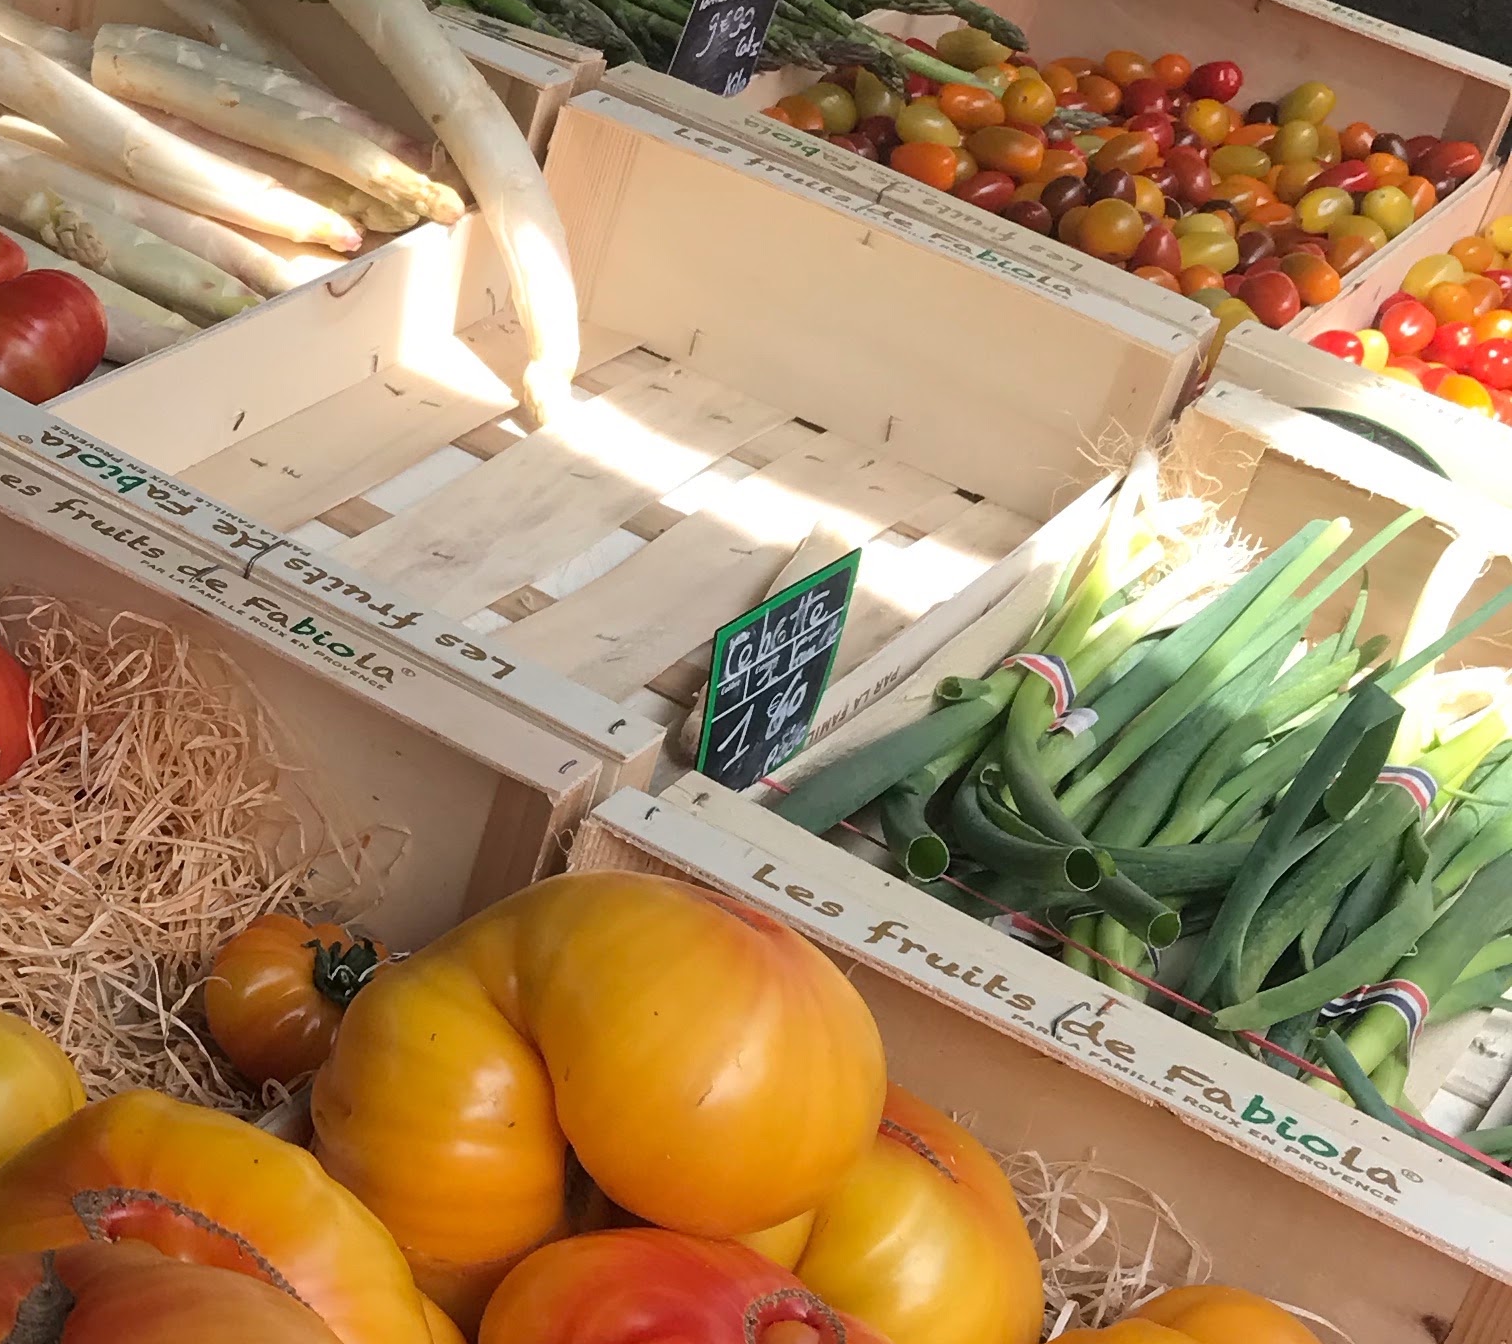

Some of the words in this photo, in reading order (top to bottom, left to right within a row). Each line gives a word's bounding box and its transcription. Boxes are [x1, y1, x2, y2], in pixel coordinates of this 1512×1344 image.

[672, 127, 733, 155] Les
[743, 157, 852, 203] fruits
[930, 232, 1073, 297] Fabiola
[50, 424, 125, 463] PROVENCE
[40, 430, 198, 517] Fabiola
[127, 463, 148, 475] EN
[150, 475, 191, 497] ROUX
[193, 496, 255, 529] FAMILLE
[212, 518, 272, 551] de
[254, 528, 279, 541] LA
[47, 498, 166, 560] fruits
[177, 563, 229, 595] de
[241, 596, 395, 685] Fabiola
[283, 557, 424, 630] fruits
[140, 560, 166, 574] PAR
[169, 574, 186, 585] LA
[187, 584, 246, 616] FAMILLE
[247, 615, 288, 638] ROUX
[290, 639, 310, 651] EN
[312, 650, 387, 691] PROVENCE
[434, 632, 517, 681] Les
[853, 688, 871, 711] LA
[873, 665, 901, 695] PAR
[808, 704, 850, 745] FAMIL
[751, 863, 845, 918] Les
[863, 920, 1037, 1012] fruits
[1061, 1019, 1137, 1064] de
[1163, 1064, 1402, 1195] Fabiola
[1011, 1013, 1053, 1036] PAR
[1088, 1050, 1177, 1096] FAMILLE
[1182, 1095, 1242, 1129] ROUX
[1247, 1128, 1277, 1146] EN
[1283, 1145, 1399, 1206] PROVENCE
